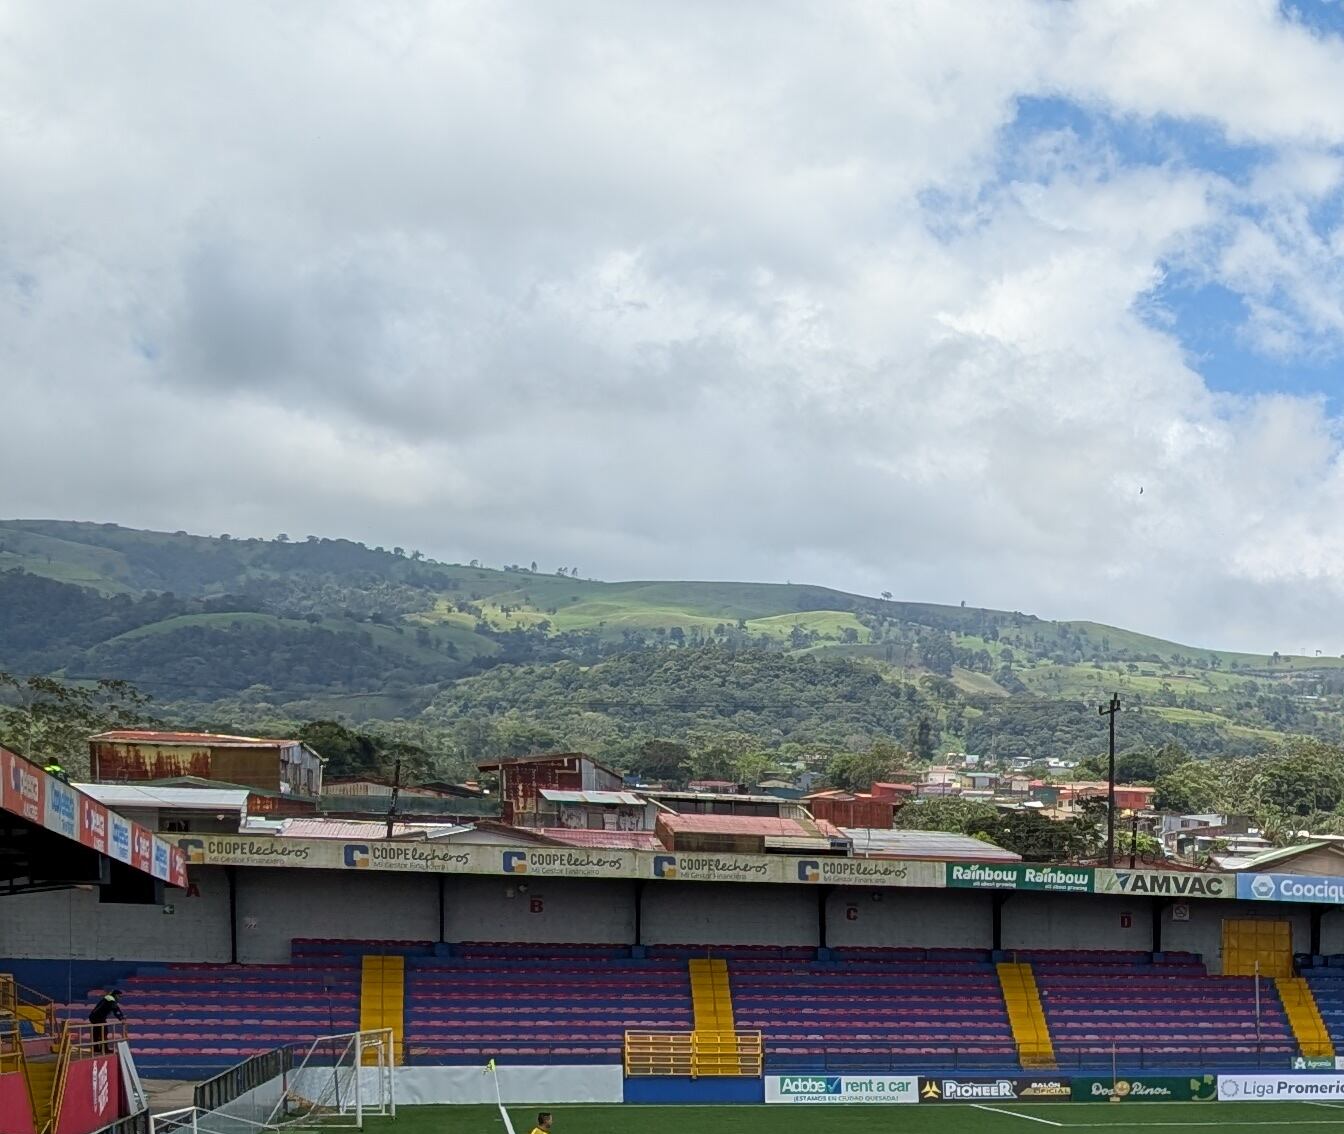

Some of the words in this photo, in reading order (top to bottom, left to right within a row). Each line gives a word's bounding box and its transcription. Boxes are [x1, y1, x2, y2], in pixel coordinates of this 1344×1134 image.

[952, 864, 1018, 881] Rainbow
[1024, 868, 1089, 885] Rainbow
[1130, 874, 1223, 898] AMVAC
[529, 899, 545, 914] B
[782, 1077, 827, 1093] Adobe
[845, 1078, 876, 1093] rent
[878, 1082, 886, 1093] a
[890, 1082, 911, 1093] car
[943, 1080, 1018, 1098] PIONEER
[1030, 1081, 1061, 1089] BALÓN
[1091, 1083, 1115, 1097] Dos
[1130, 1082, 1171, 1097] Pinos
[1243, 1080, 1274, 1097] Liga
